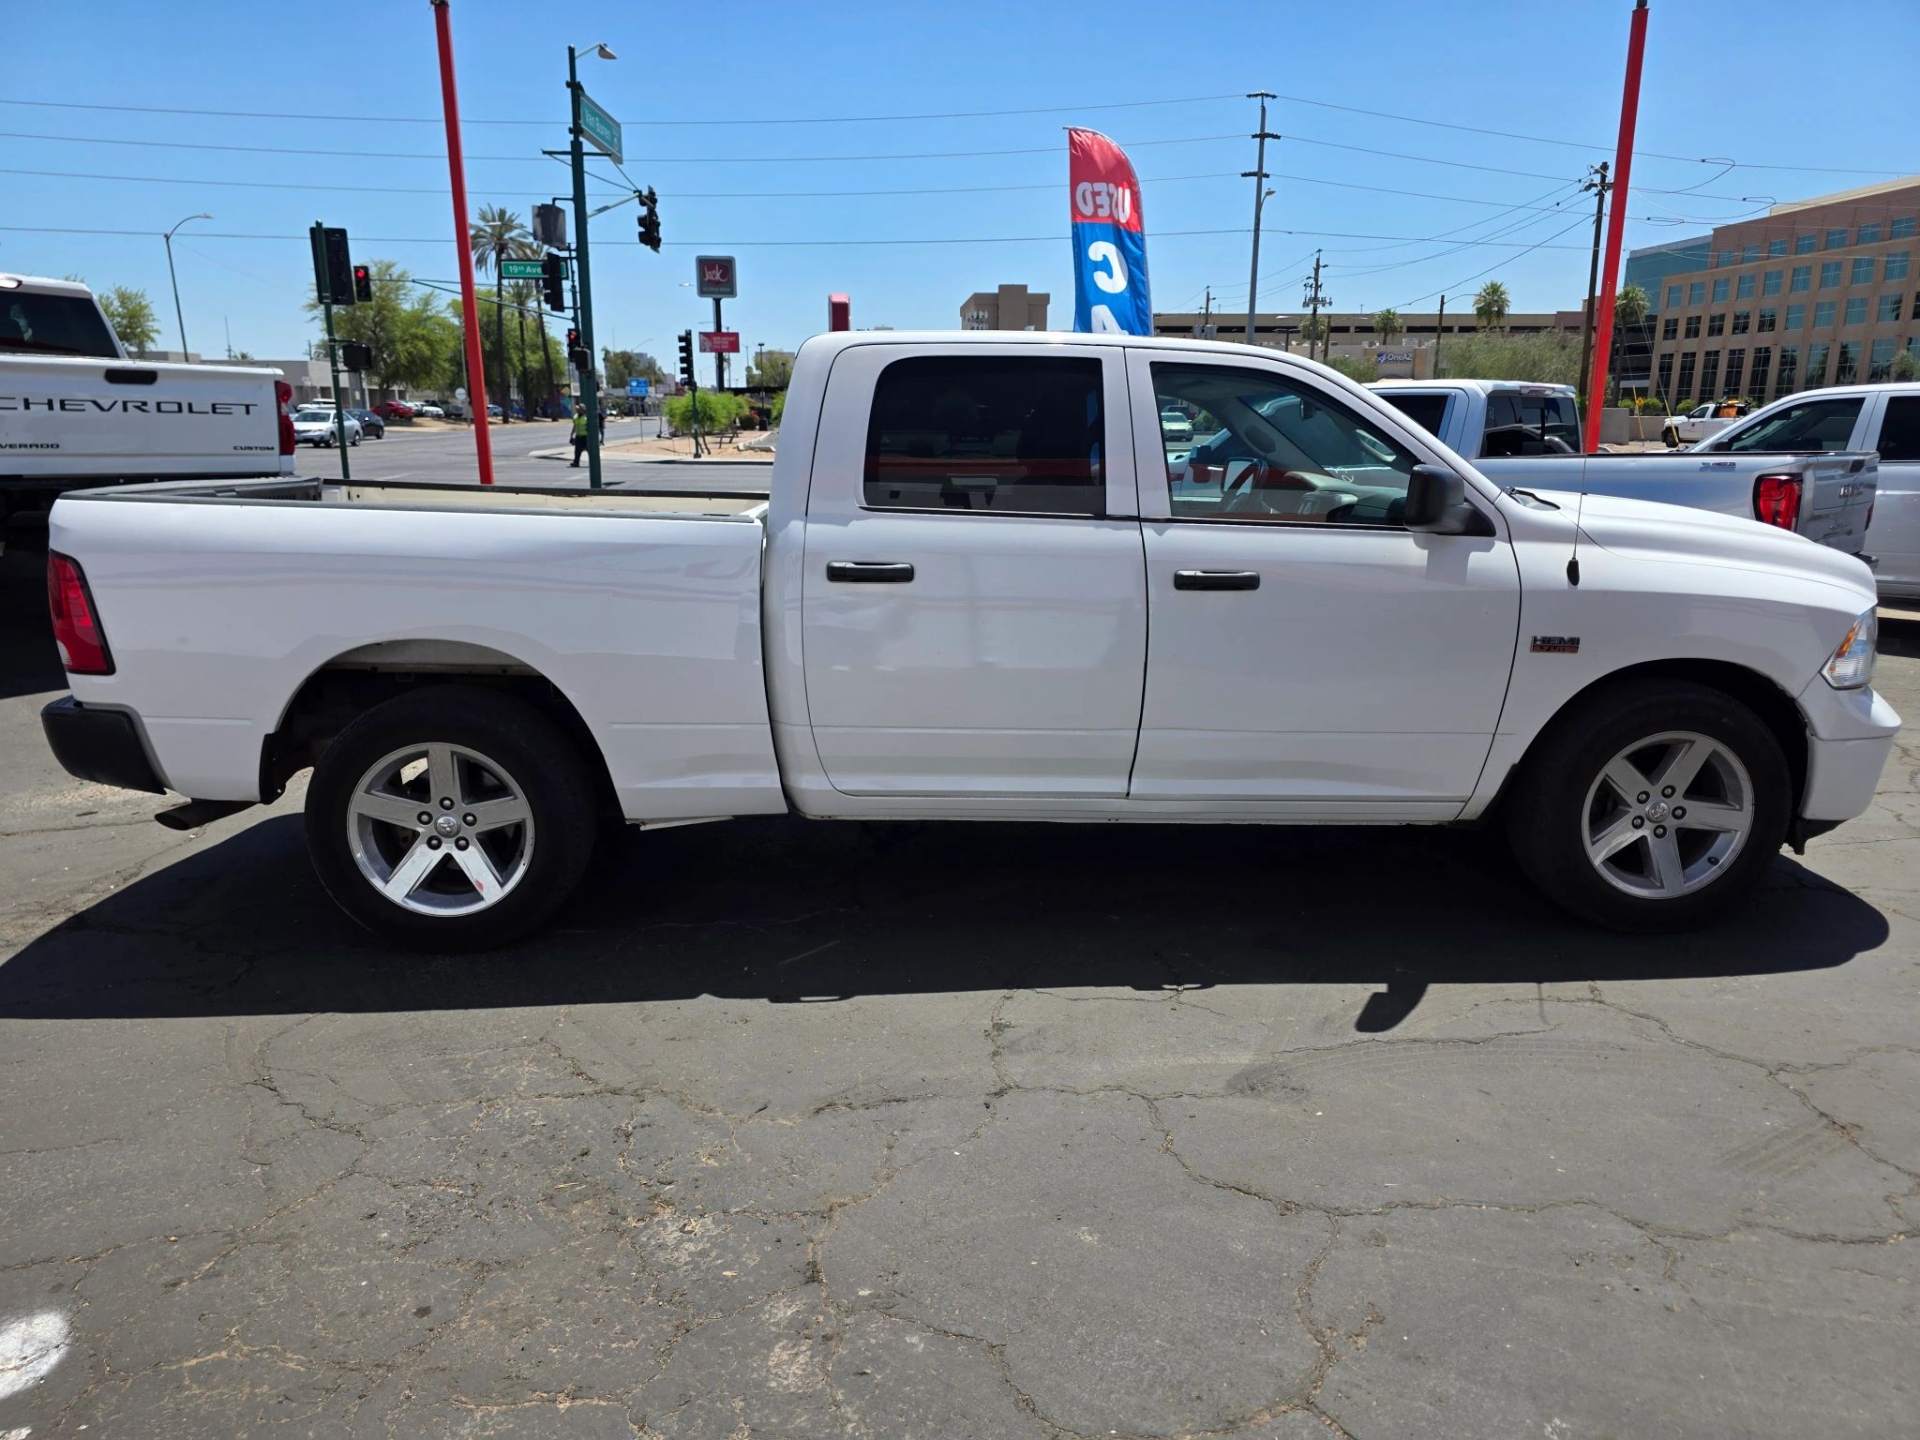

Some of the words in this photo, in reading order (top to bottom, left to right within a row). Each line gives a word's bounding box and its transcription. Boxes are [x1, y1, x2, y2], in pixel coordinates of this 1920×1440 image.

[509, 265, 524, 273] 19th
[704, 264, 729, 282] Jack
[1387, 353, 1412, 361] OneAZ
[1531, 636, 1580, 645] HEMI
